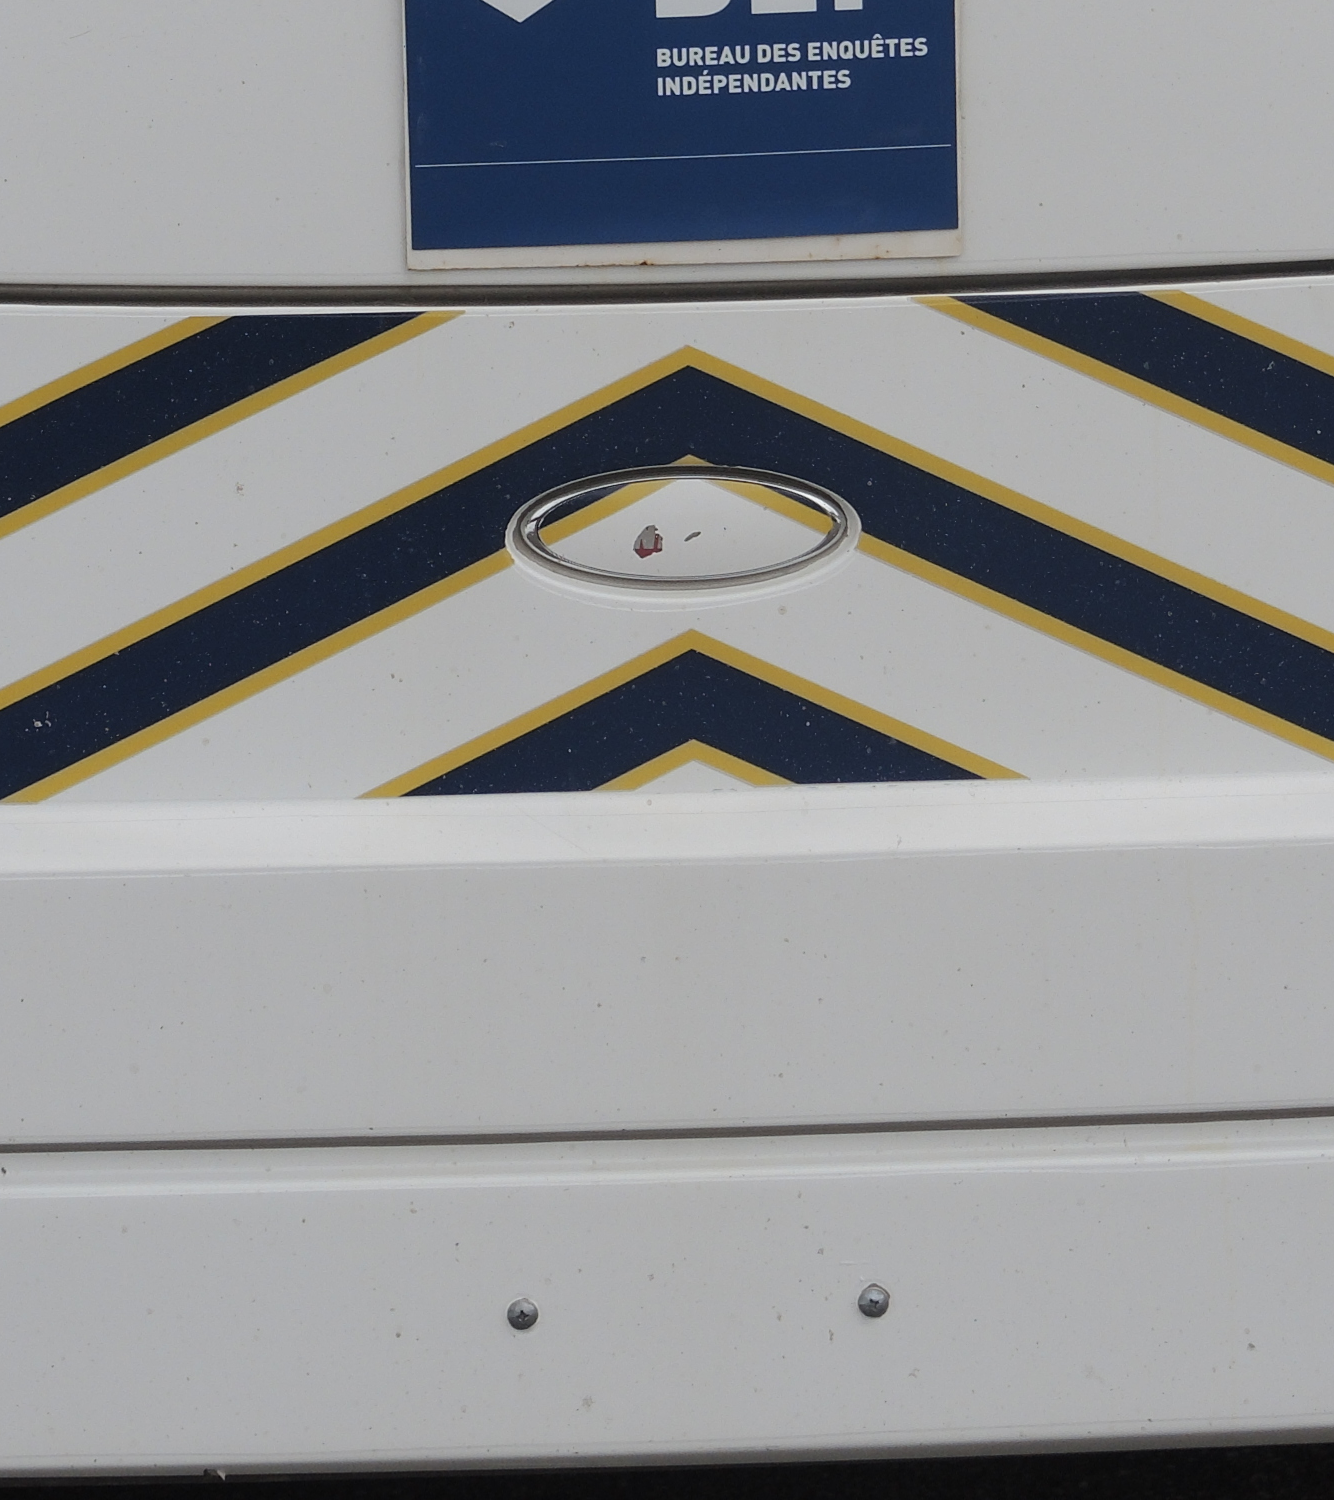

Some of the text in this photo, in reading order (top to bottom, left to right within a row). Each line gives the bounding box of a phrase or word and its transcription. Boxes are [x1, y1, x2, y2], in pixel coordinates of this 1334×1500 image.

[657, 33, 927, 67] BUREAU DES ENQUÊTES
[658, 70, 851, 96] INDÉPENDANTES
